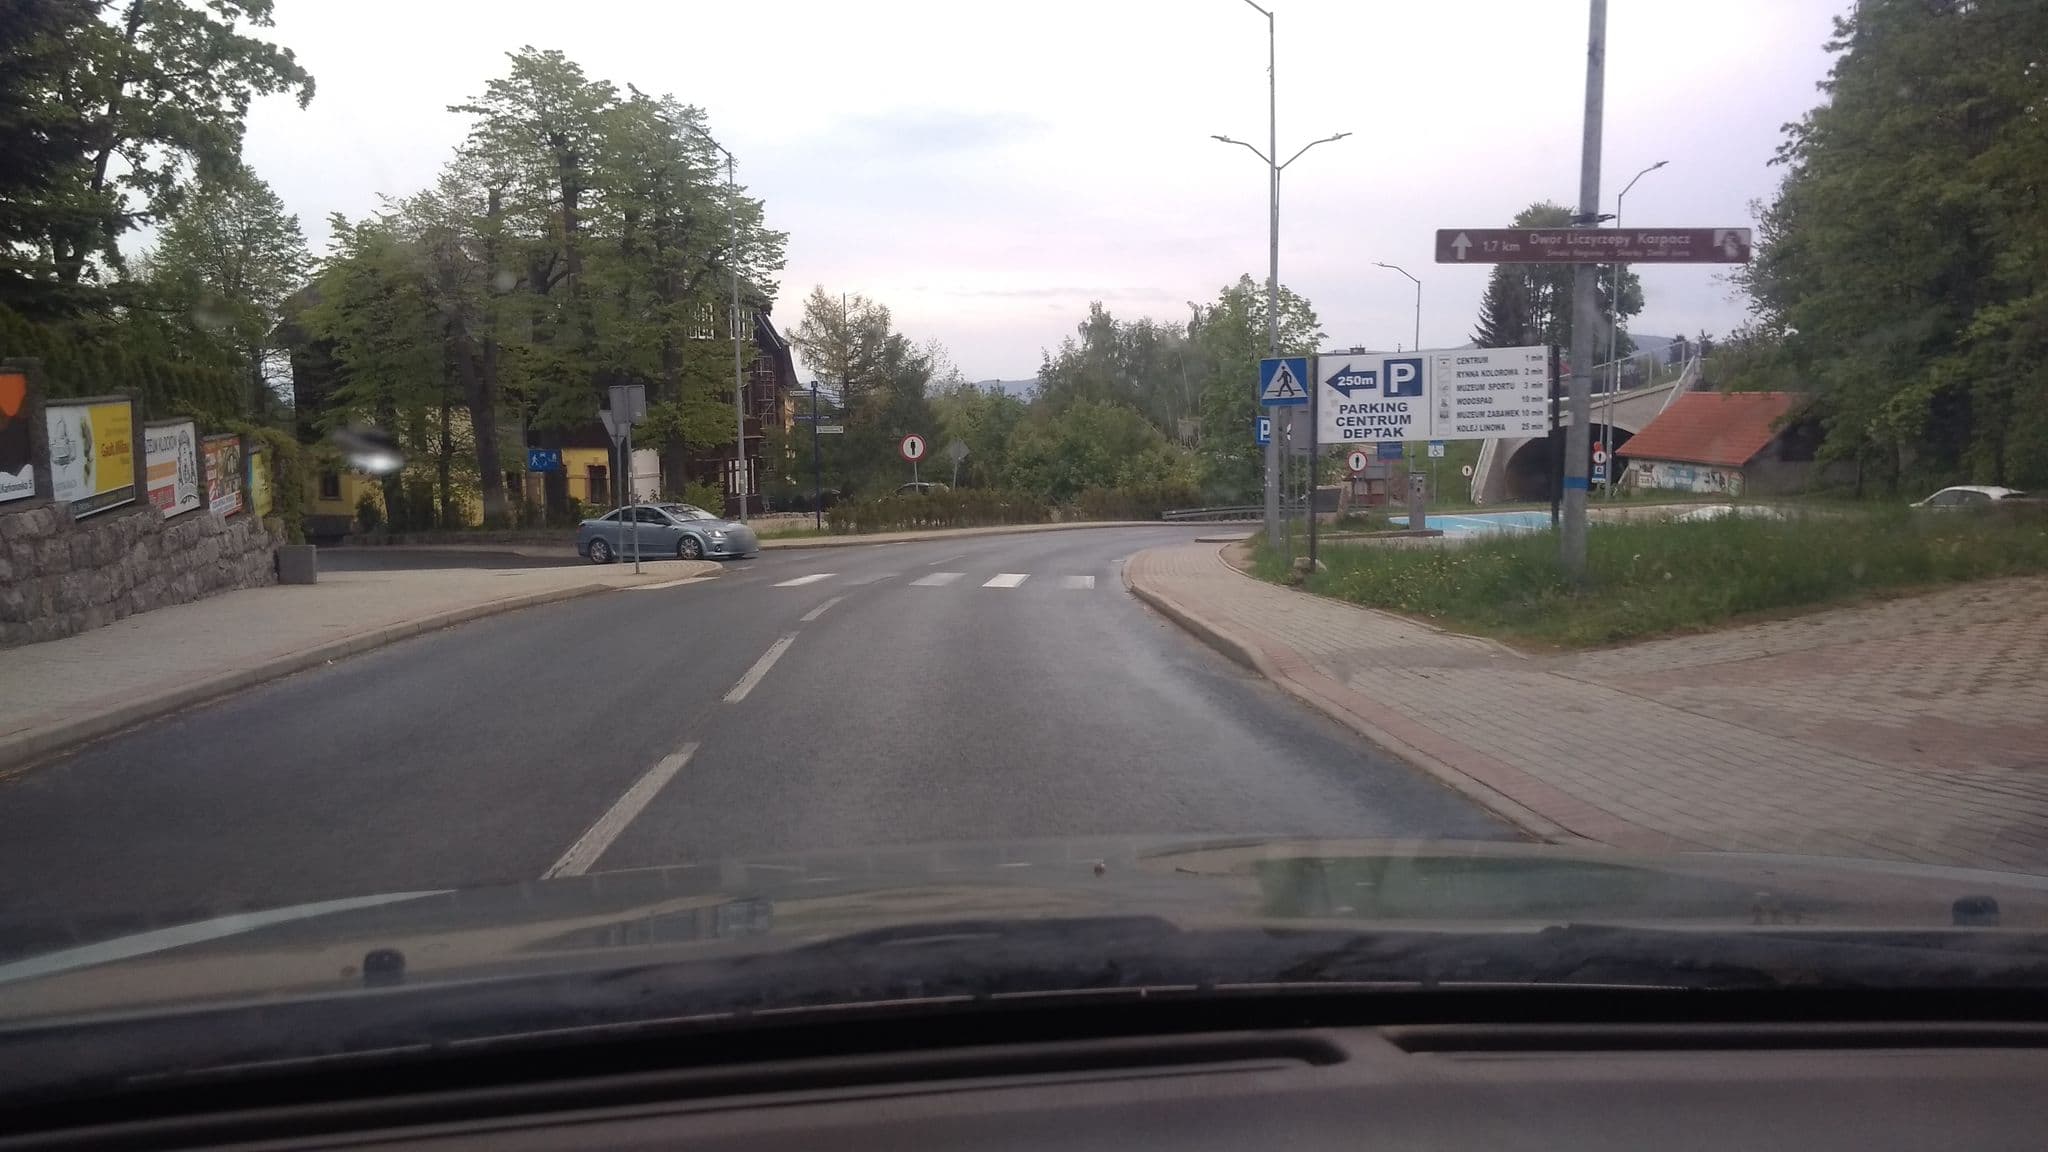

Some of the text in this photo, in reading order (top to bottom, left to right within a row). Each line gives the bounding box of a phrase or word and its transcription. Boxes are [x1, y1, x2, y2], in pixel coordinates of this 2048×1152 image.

[1502, 240, 1520, 251] km
[1636, 233, 1691, 247] Karpacz
[1456, 356, 1489, 365] CENTRUM
[1531, 354, 1544, 362] min
[1390, 363, 1415, 393] P
[1456, 370, 1479, 378] RYNNA
[1337, 376, 1373, 386] 250m
[1456, 384, 1486, 392] MUZEUM
[1488, 382, 1515, 390] SPORTU
[1531, 381, 1544, 389] min
[1456, 397, 1493, 405] WODOSPAD
[1339, 402, 1408, 414] PARKING
[1456, 411, 1486, 419] MUZEUM
[1487, 409, 1521, 418] ZABAWEK
[1335, 414, 1412, 427] CENTRUM
[1260, 420, 1270, 440] P
[1343, 427, 1404, 439] DEPTAK
[1480, 424, 1505, 432] LINOWA
[1522, 423, 1530, 431] 25
